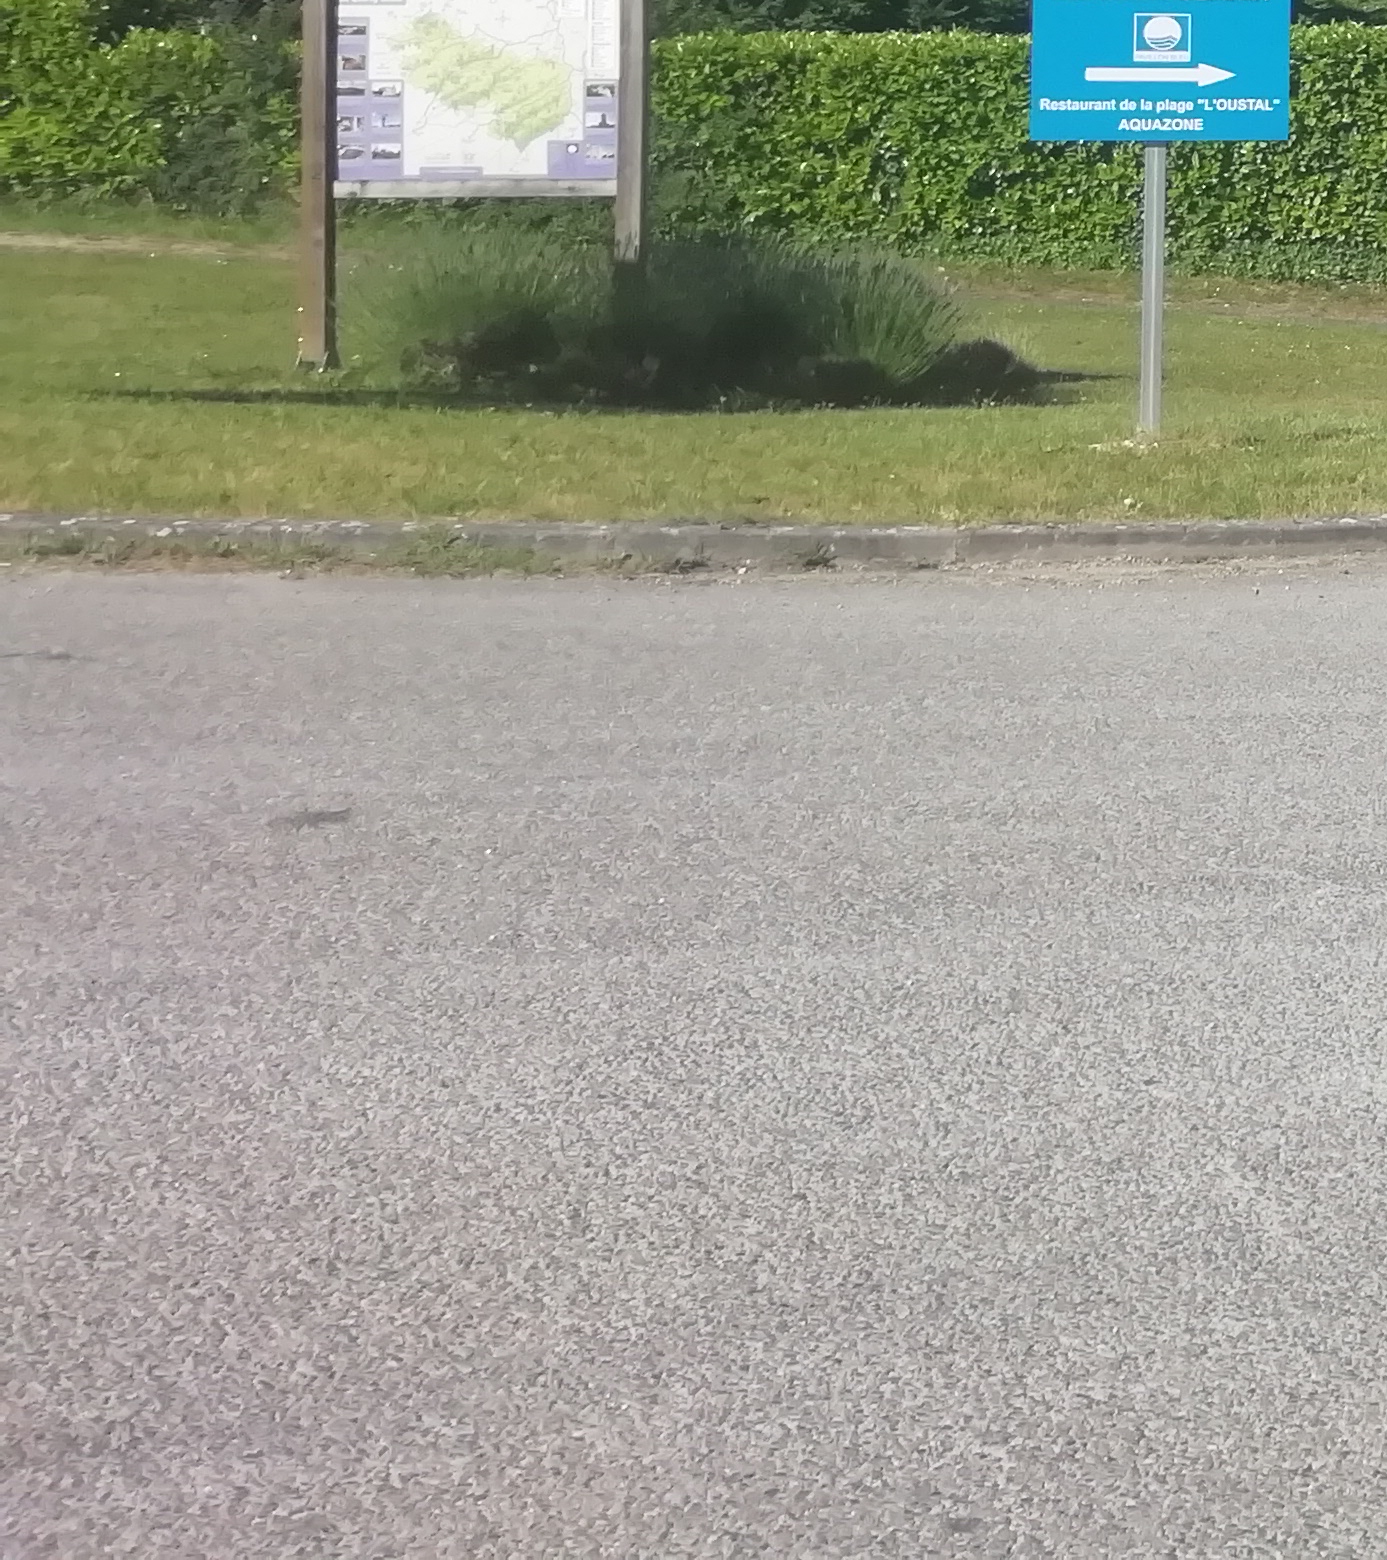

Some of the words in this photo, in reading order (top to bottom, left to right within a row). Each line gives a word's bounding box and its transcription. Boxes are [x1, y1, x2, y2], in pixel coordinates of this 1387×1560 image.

[1039, 98, 1117, 111] Restaurant
[1119, 99, 1137, 111] de
[1140, 99, 1153, 111] la
[1156, 99, 1194, 114] plage
[1198, 97, 1281, 111] "L'OUSTAL"
[1118, 118, 1205, 131] AQUAZONE
